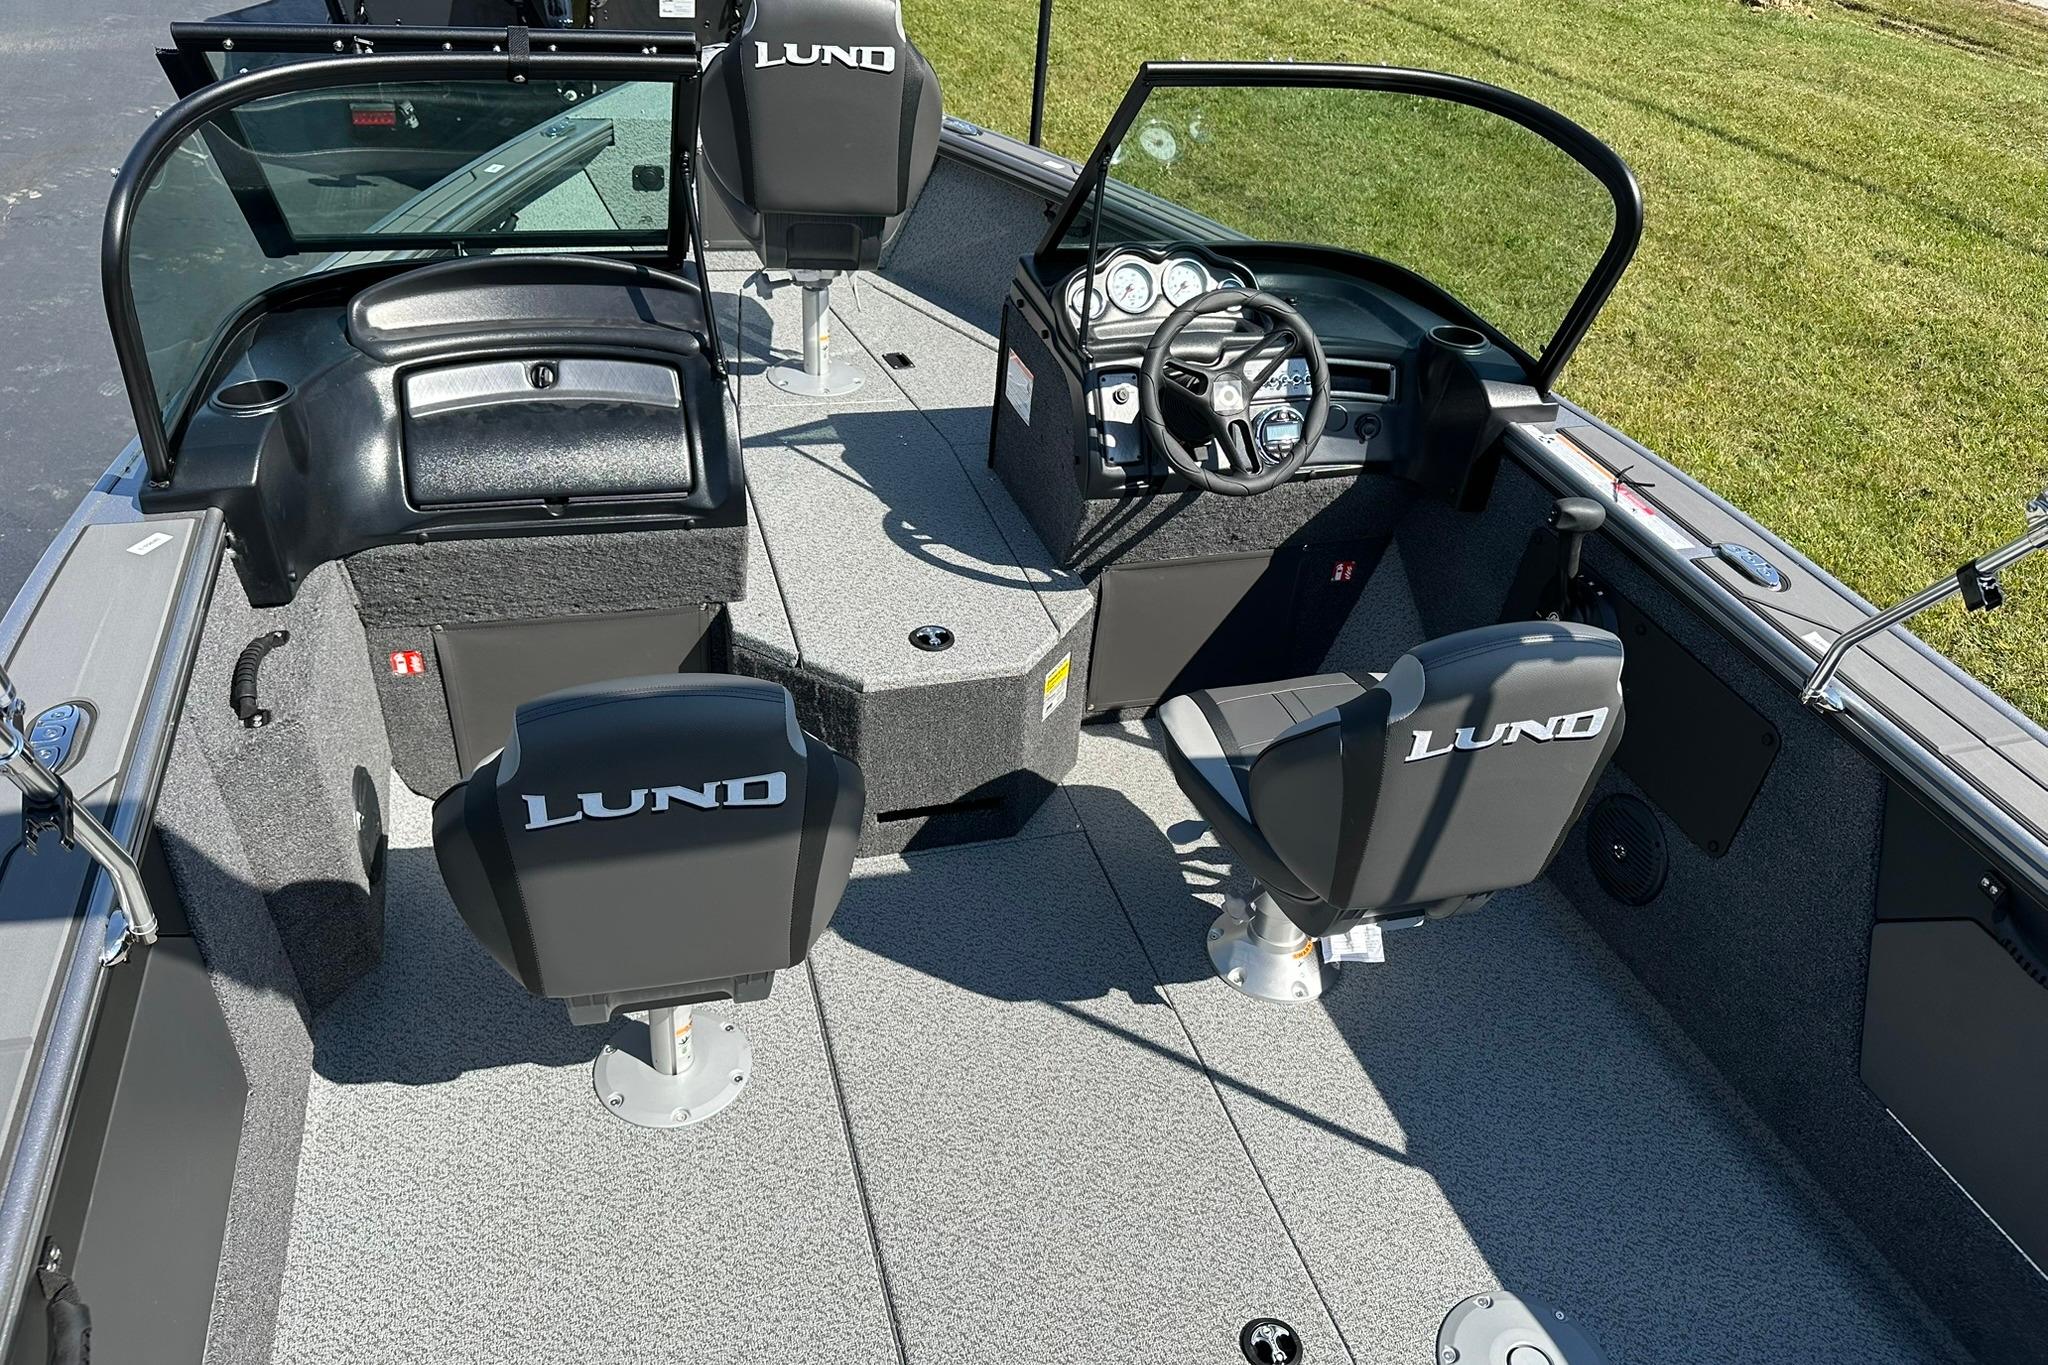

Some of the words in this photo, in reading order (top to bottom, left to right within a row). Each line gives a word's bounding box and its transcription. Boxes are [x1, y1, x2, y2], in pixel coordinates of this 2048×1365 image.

[755, 41, 896, 73] LUND
[1404, 706, 1610, 763] LUND
[521, 771, 787, 830] LUND
